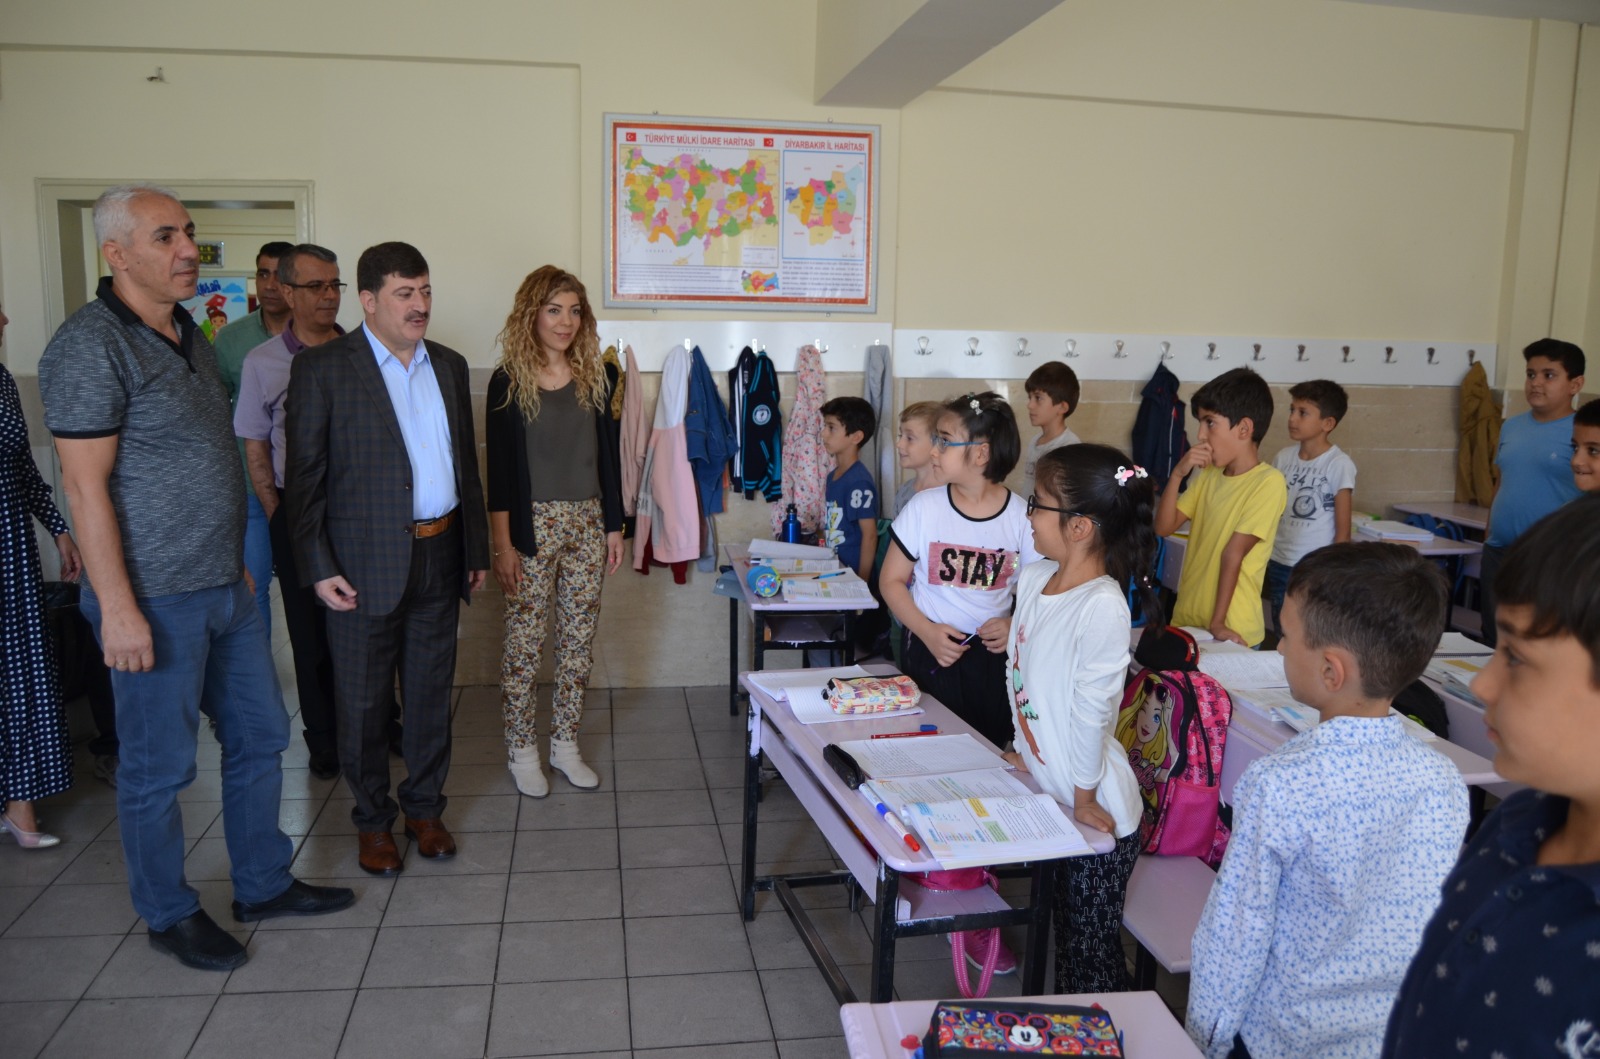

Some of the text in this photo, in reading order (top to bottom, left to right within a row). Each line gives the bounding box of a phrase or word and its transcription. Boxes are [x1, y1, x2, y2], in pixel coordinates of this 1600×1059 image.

[644, 133, 755, 147] TÜRKİYE MÜLKİ İDARE HARİTASI
[785, 139, 826, 150] DİYARBAKIR
[834, 140, 865, 151] HARİTASI
[1289, 473, 1306, 486] 34
[850, 489, 874, 509] 87
[939, 548, 1006, 587] STAY
